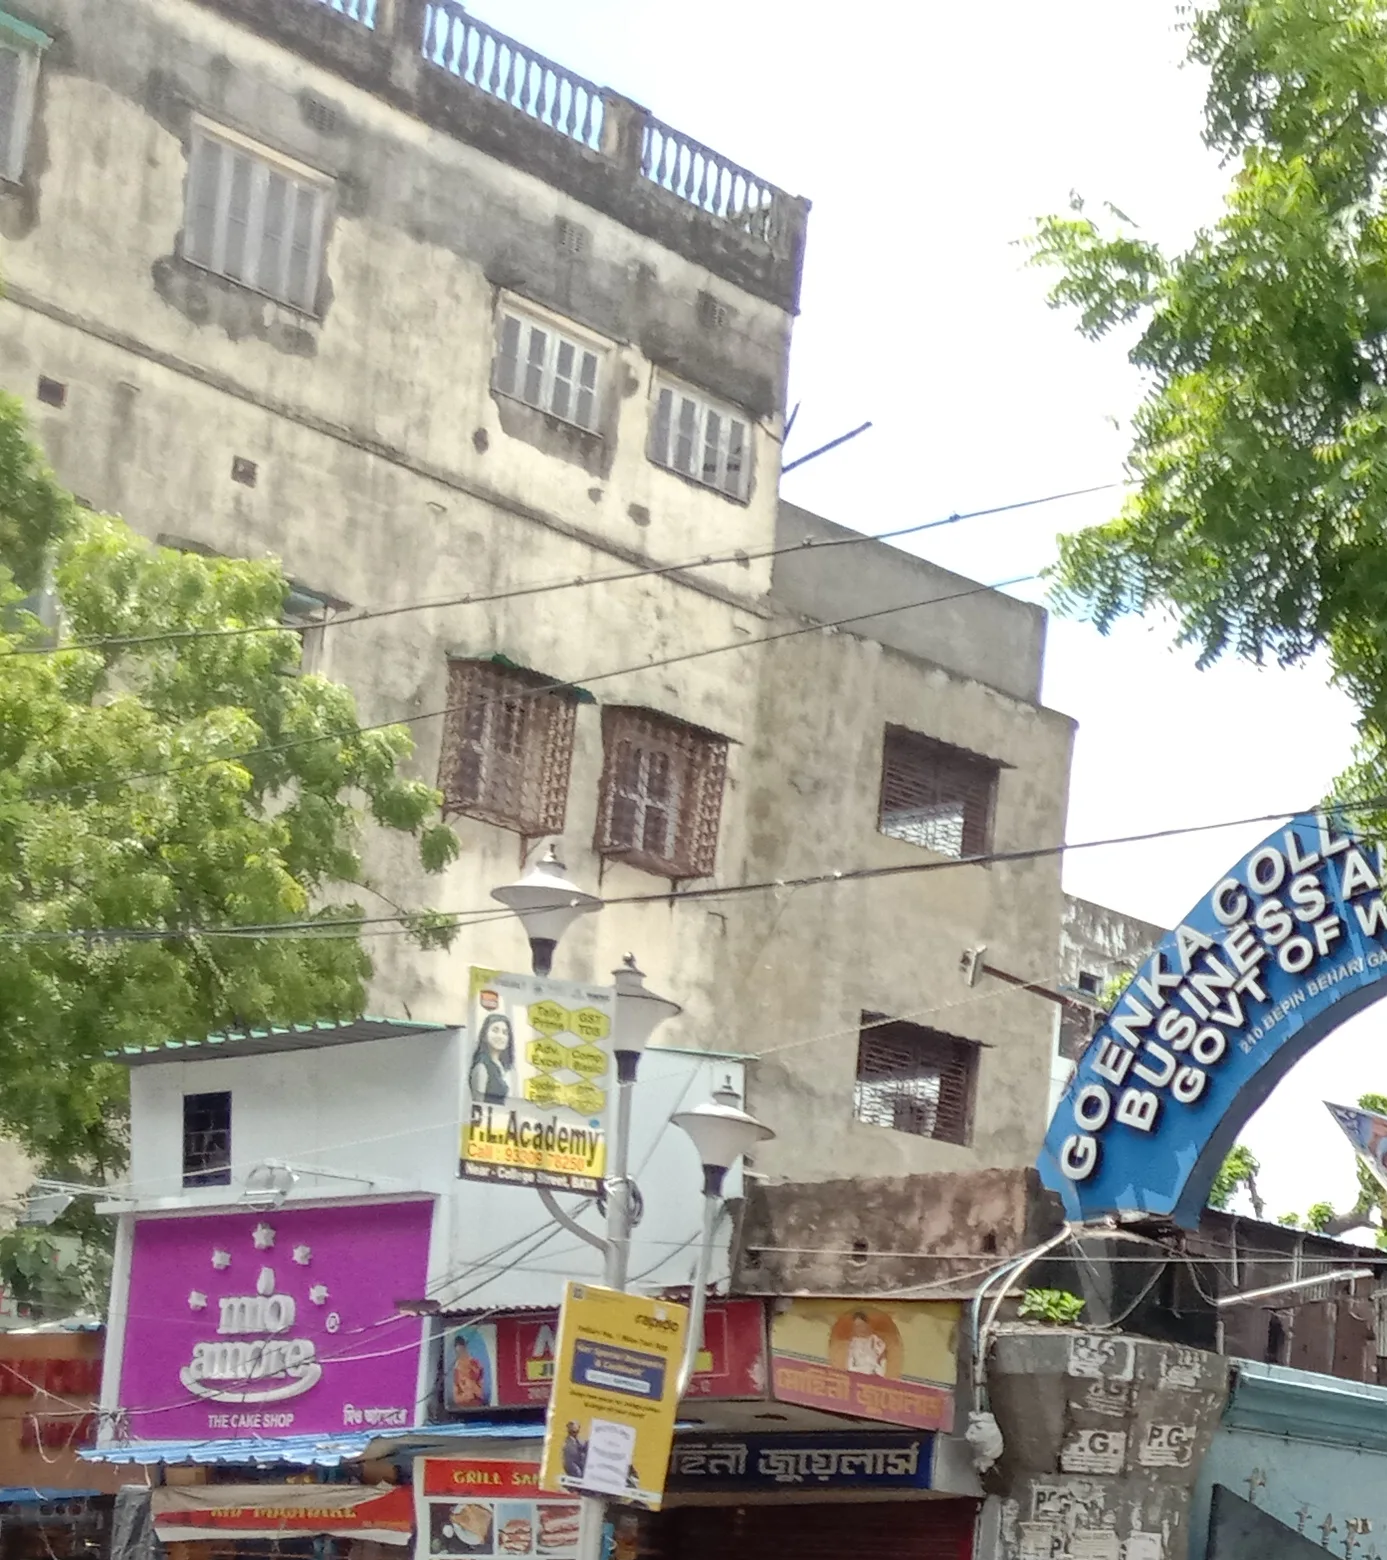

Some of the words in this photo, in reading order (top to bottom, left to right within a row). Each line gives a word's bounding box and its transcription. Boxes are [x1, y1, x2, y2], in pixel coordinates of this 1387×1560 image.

[1116, 873, 1325, 1132] BUSINESS
[1171, 966, 1267, 1103] GOVT
[1278, 917, 1342, 974] OF
[1238, 1028, 1264, 1054] 210
[1263, 988, 1306, 1031] BEPIN
[1307, 956, 1364, 998] BEHARI
[1061, 923, 1215, 1181] GOENKA
[469, 1104, 600, 1168] P.L.Academy
[217, 1293, 296, 1334] mio
[190, 1338, 316, 1379] amore
[208, 1414, 230, 1428] THE
[232, 1413, 261, 1427] CAKE
[263, 1413, 294, 1427] SHOP
[453, 1469, 503, 1487] GRILL
[758, 1440, 920, 1483] জুয়েলার্স
